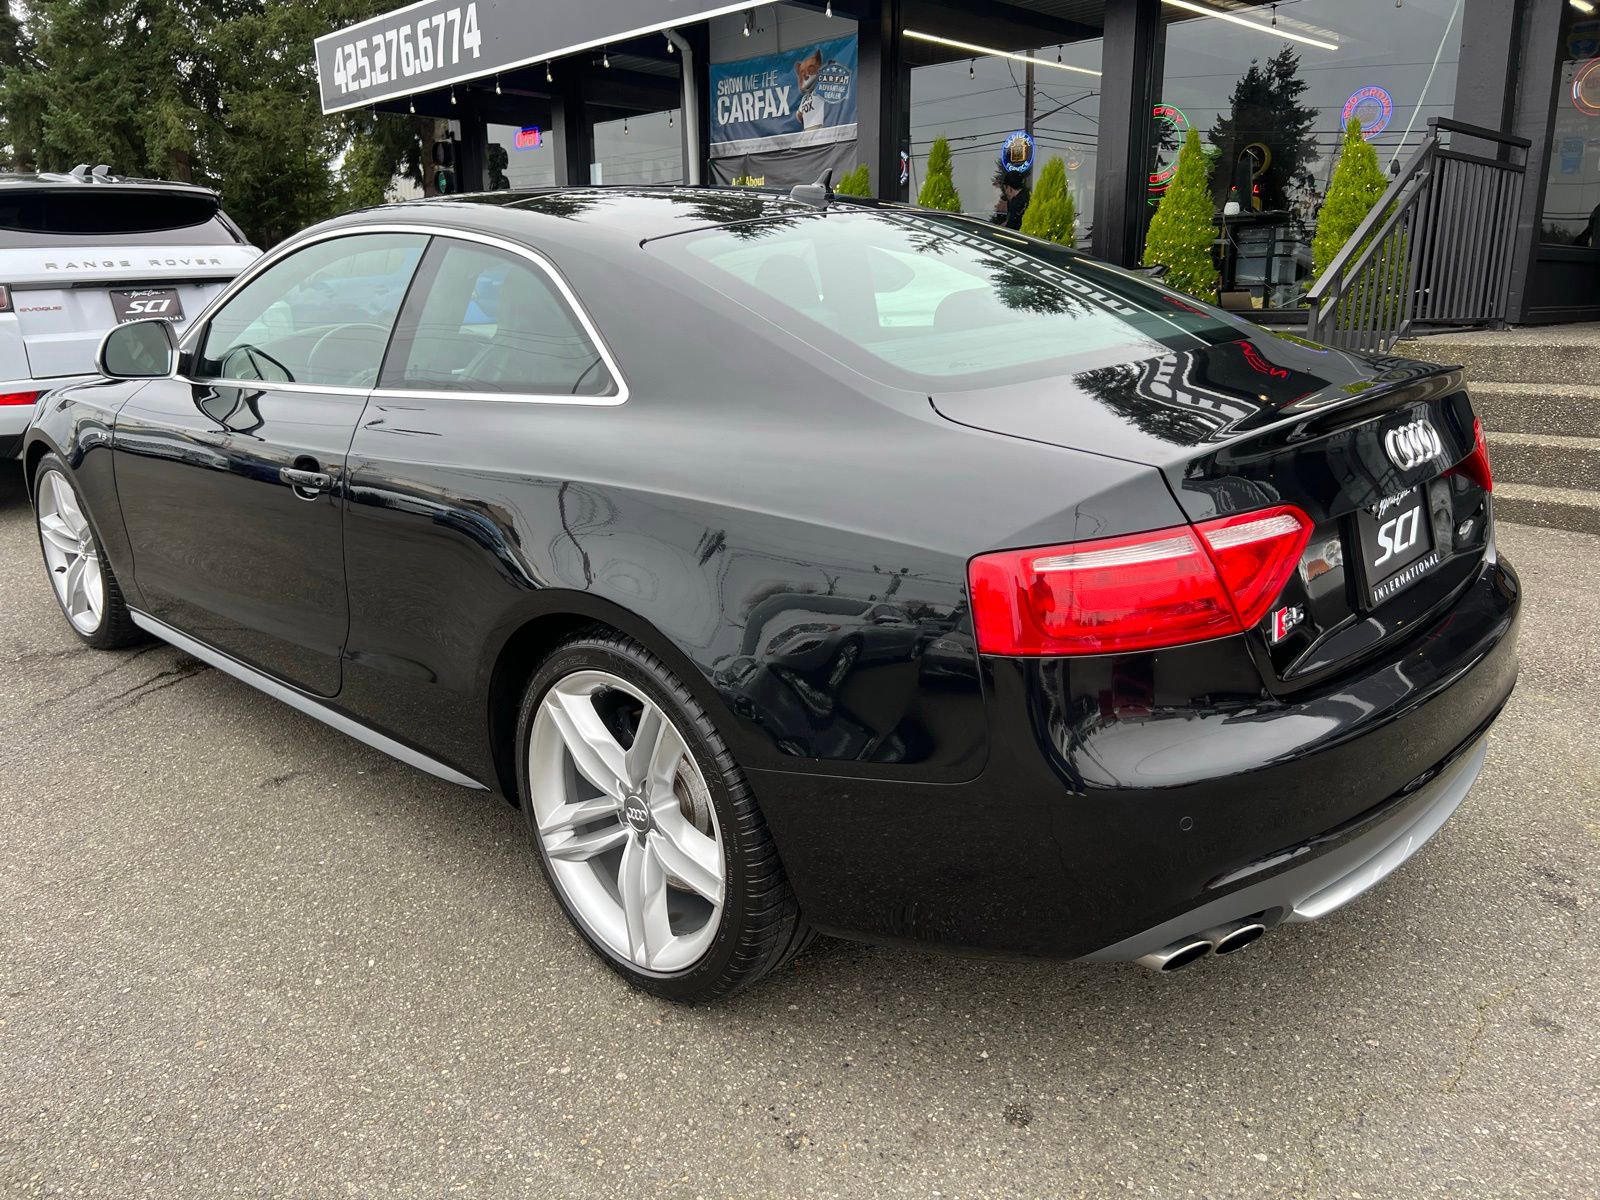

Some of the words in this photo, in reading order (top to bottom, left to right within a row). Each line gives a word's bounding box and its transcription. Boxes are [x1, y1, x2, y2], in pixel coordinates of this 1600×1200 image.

[333, 2, 482, 94] 425.276.6774
[717, 75, 743, 96] SHOW
[744, 72, 759, 90] ME
[762, 70, 778, 88] THE
[717, 85, 791, 125] CARFAX
[745, 176, 765, 187] About
[45, 260, 131, 270] RANGE
[148, 258, 222, 267] ROVER
[125, 299, 171, 314] SCI
[1374, 505, 1420, 567] SCI
[1373, 554, 1439, 602] INTERNATIONAL
